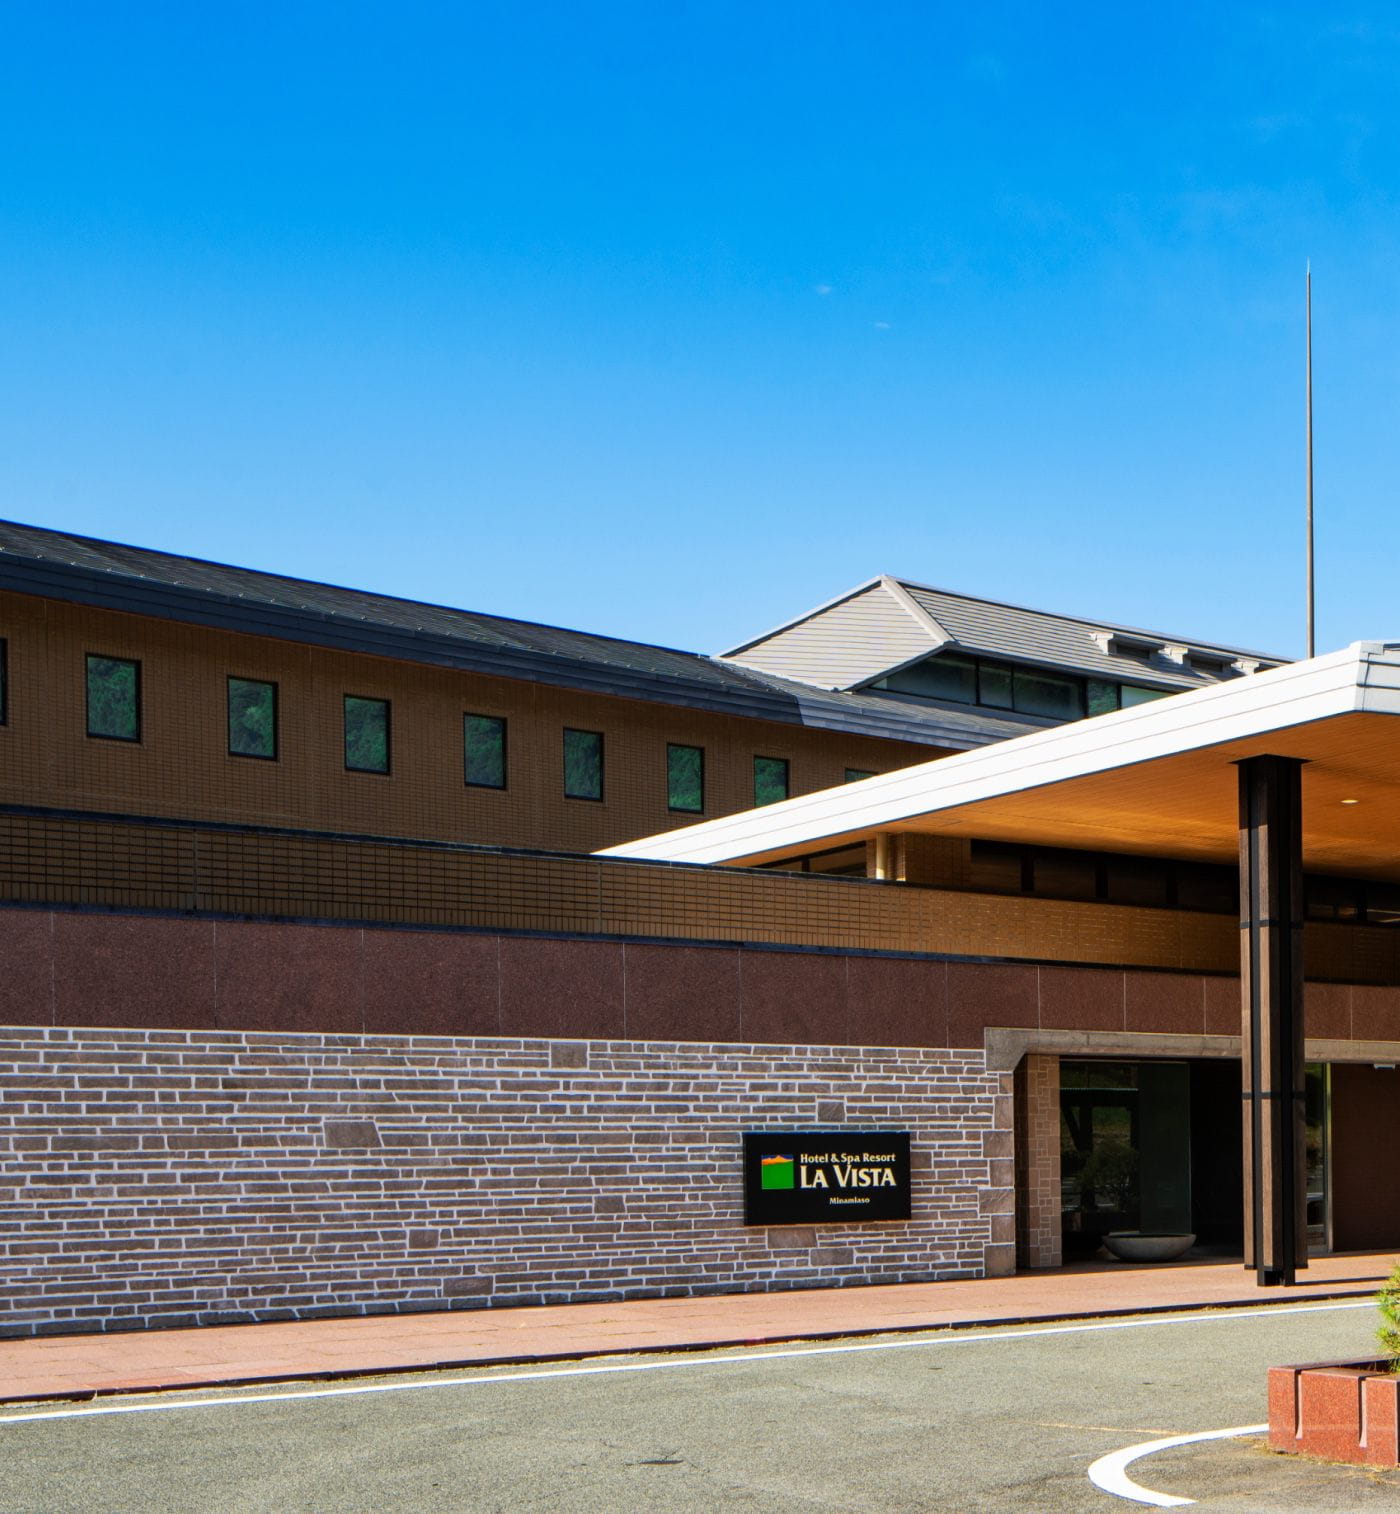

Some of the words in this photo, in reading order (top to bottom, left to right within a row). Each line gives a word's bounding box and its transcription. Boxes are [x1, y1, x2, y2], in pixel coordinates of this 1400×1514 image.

[800, 1153, 829, 1163] Hotel
[830, 1152, 840, 1162] &
[840, 1152, 861, 1165] Spa
[862, 1152, 896, 1162] Resort
[800, 1165, 829, 1188] LA
[829, 1196, 871, 1205] Minamiaso
